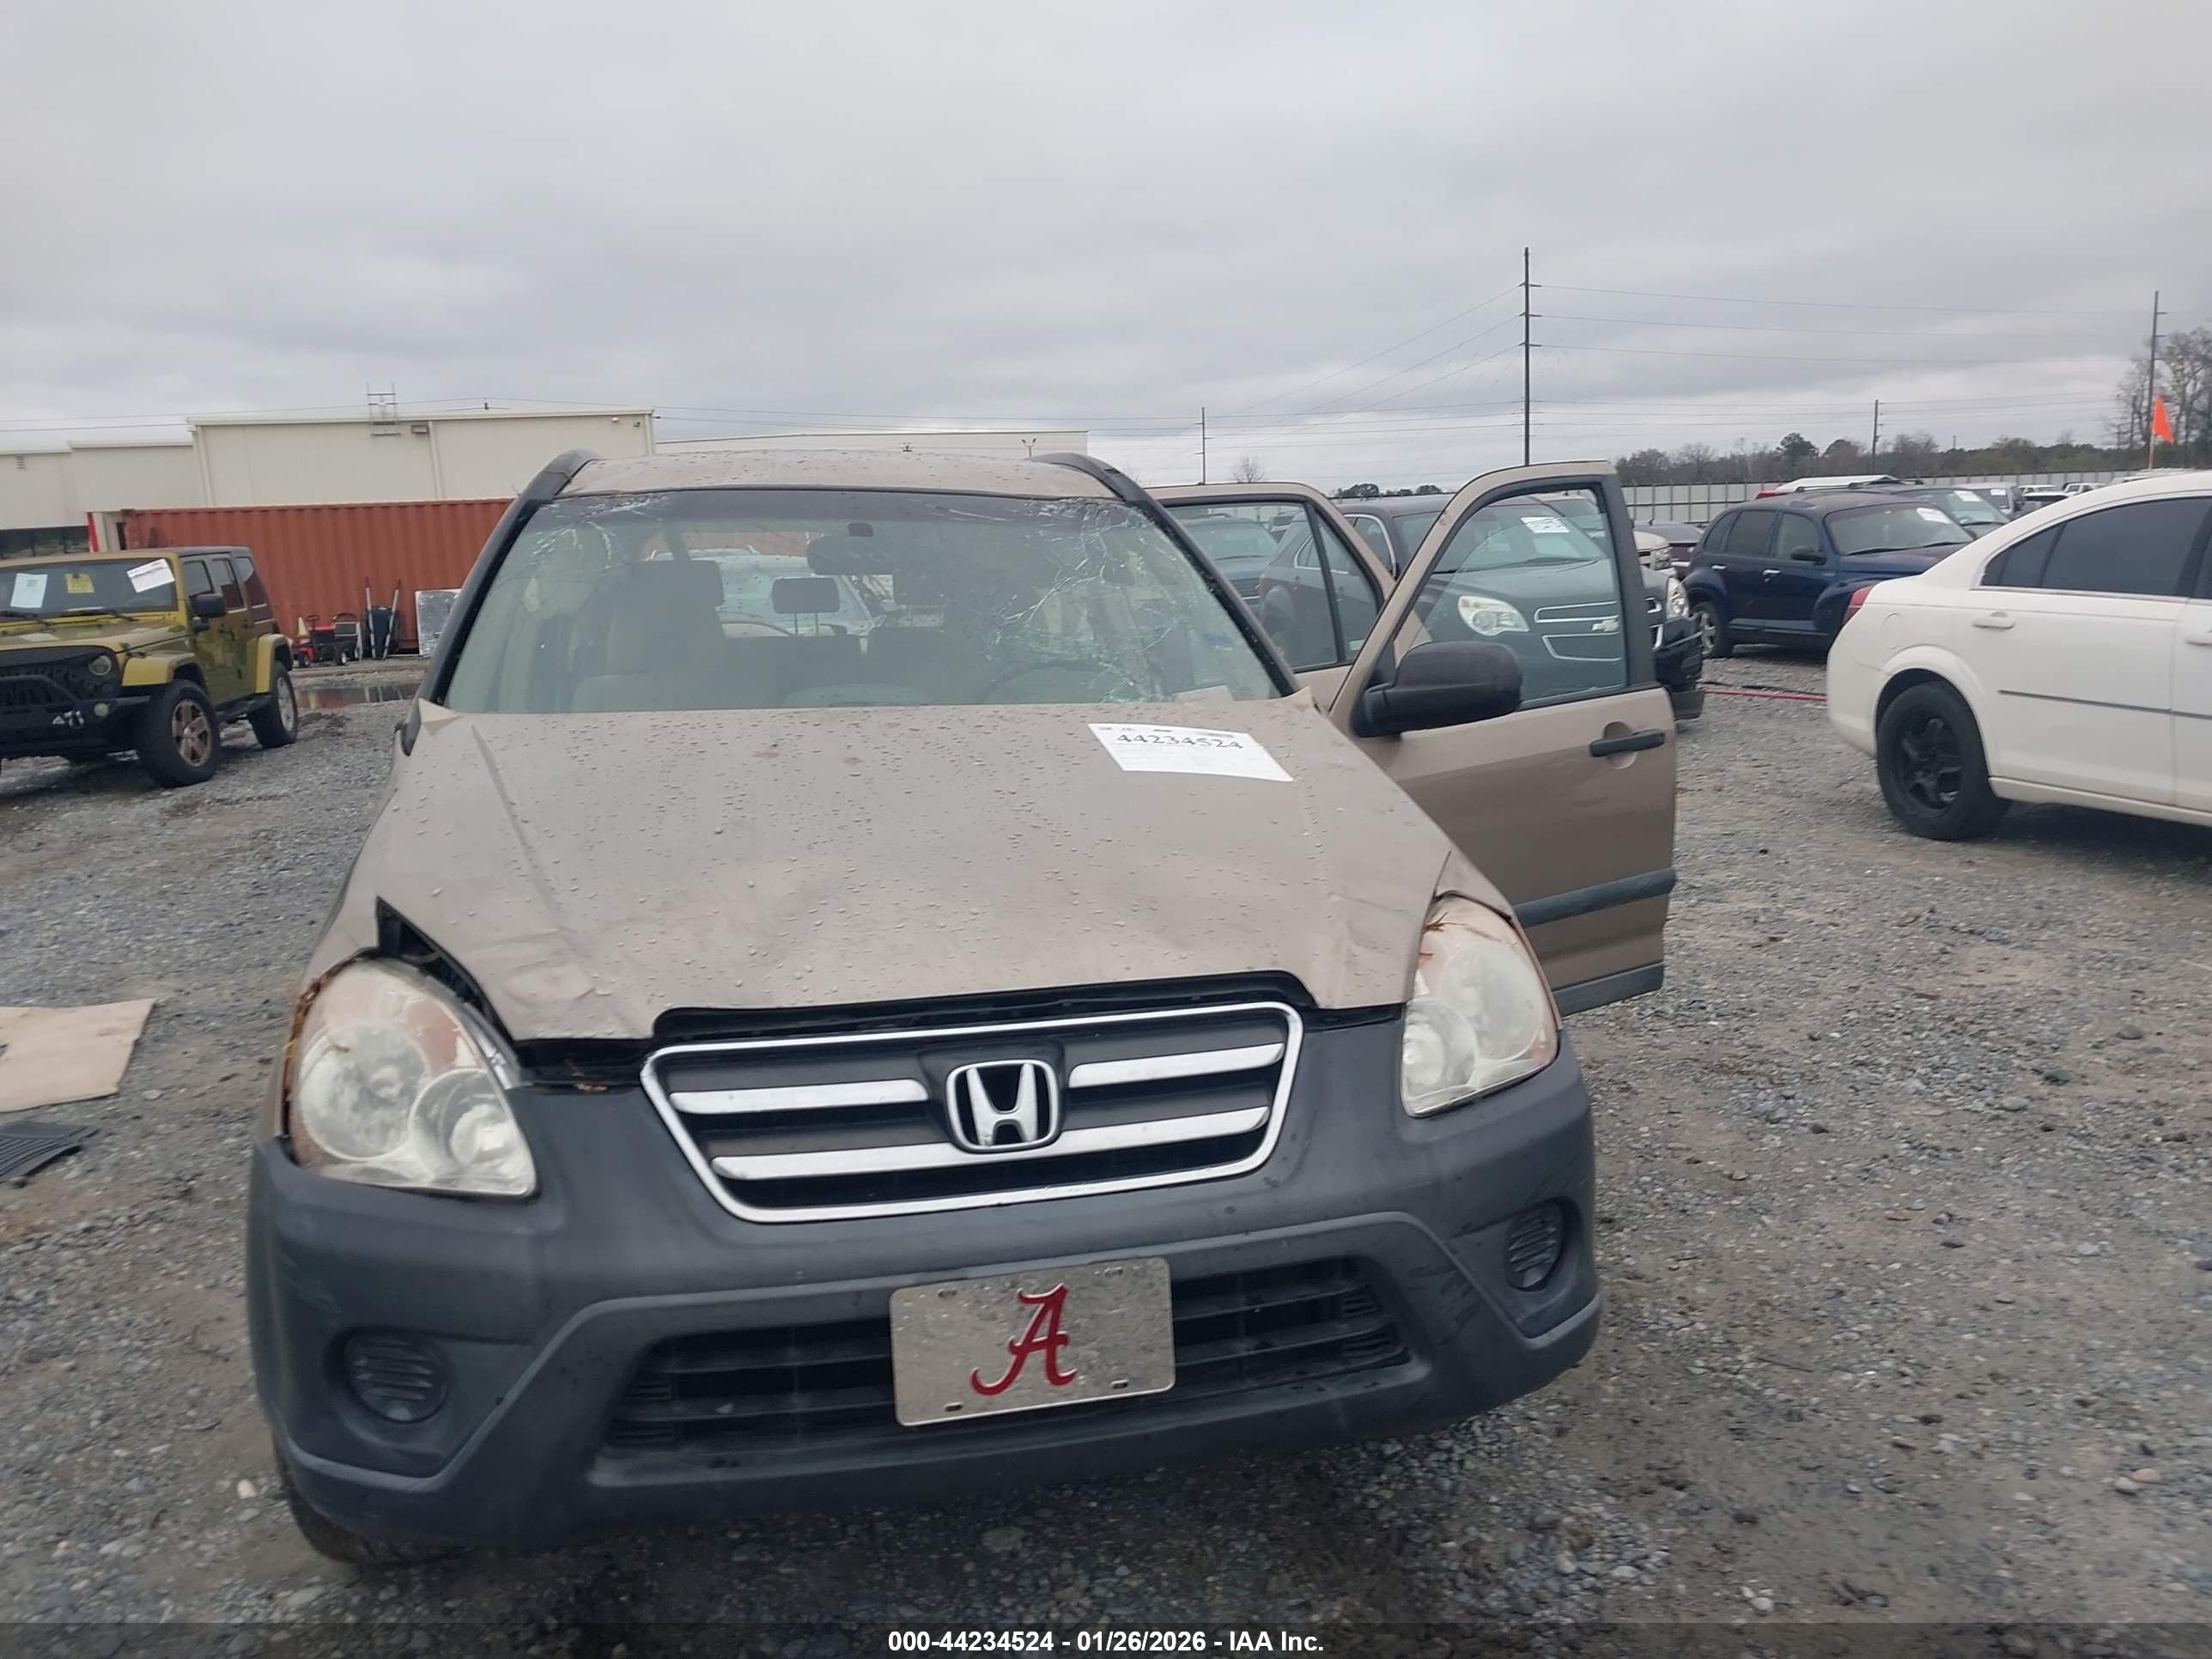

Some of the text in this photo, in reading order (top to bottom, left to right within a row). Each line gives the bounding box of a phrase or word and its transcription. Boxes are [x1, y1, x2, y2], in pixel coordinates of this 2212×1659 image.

[1116, 733, 1244, 750] 44234524
[966, 1062, 1038, 1146] H
[970, 1282, 1078, 1396] A
